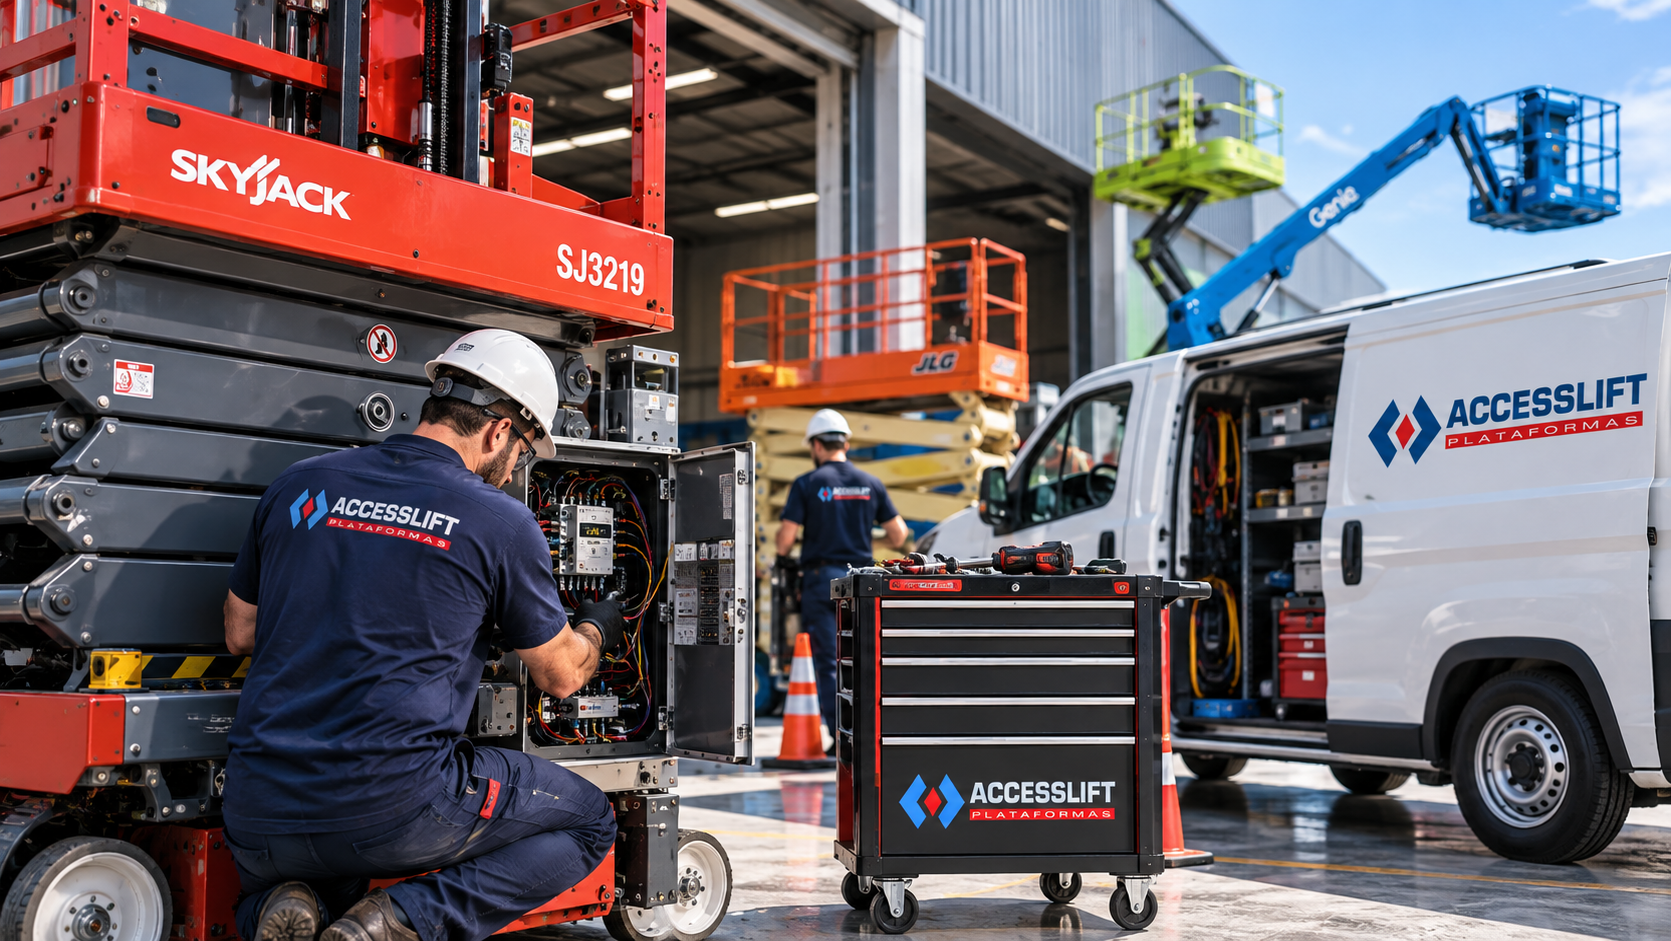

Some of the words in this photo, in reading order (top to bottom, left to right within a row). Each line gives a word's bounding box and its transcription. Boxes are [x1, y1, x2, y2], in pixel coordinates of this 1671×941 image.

[170, 149, 351, 220] SKYJACK
[1309, 186, 1360, 228] Genie
[557, 243, 645, 296] SJ3219
[911, 351, 958, 375] JLG
[1446, 373, 1647, 428] ACCESSLIFT
[1448, 415, 1638, 447] PLATAFORMAS
[331, 497, 460, 536] ACCESSLIFT
[970, 781, 1115, 804] ACCESSLIFT
[972, 810, 1111, 819] PLATAFORMAS
